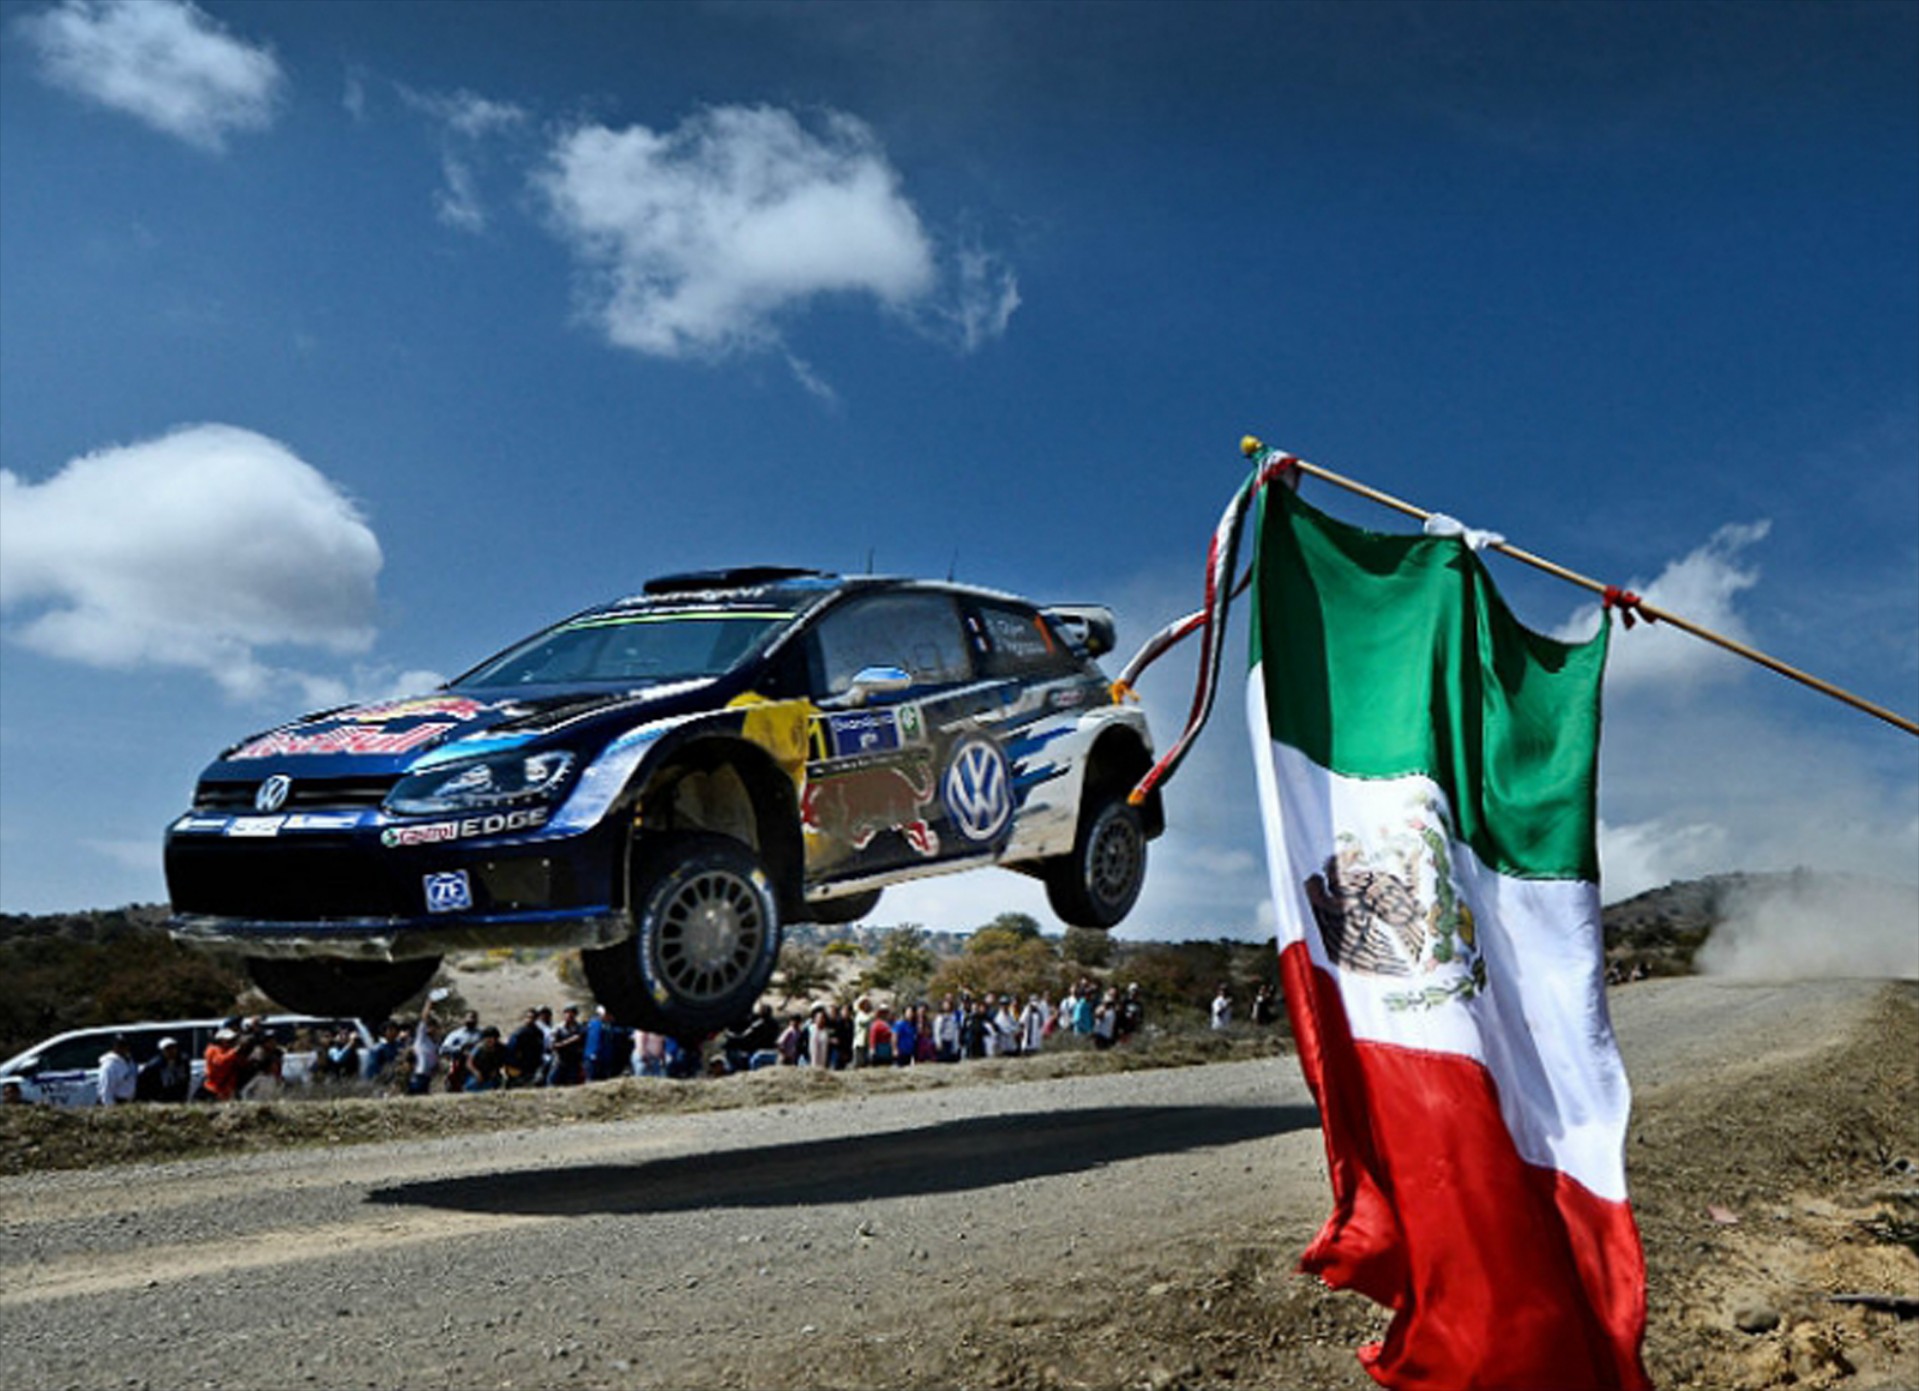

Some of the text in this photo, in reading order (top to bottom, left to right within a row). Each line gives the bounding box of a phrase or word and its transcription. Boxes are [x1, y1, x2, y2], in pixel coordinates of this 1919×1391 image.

[947, 741, 1010, 840] VW
[400, 806, 549, 845] Castrol EDGE
